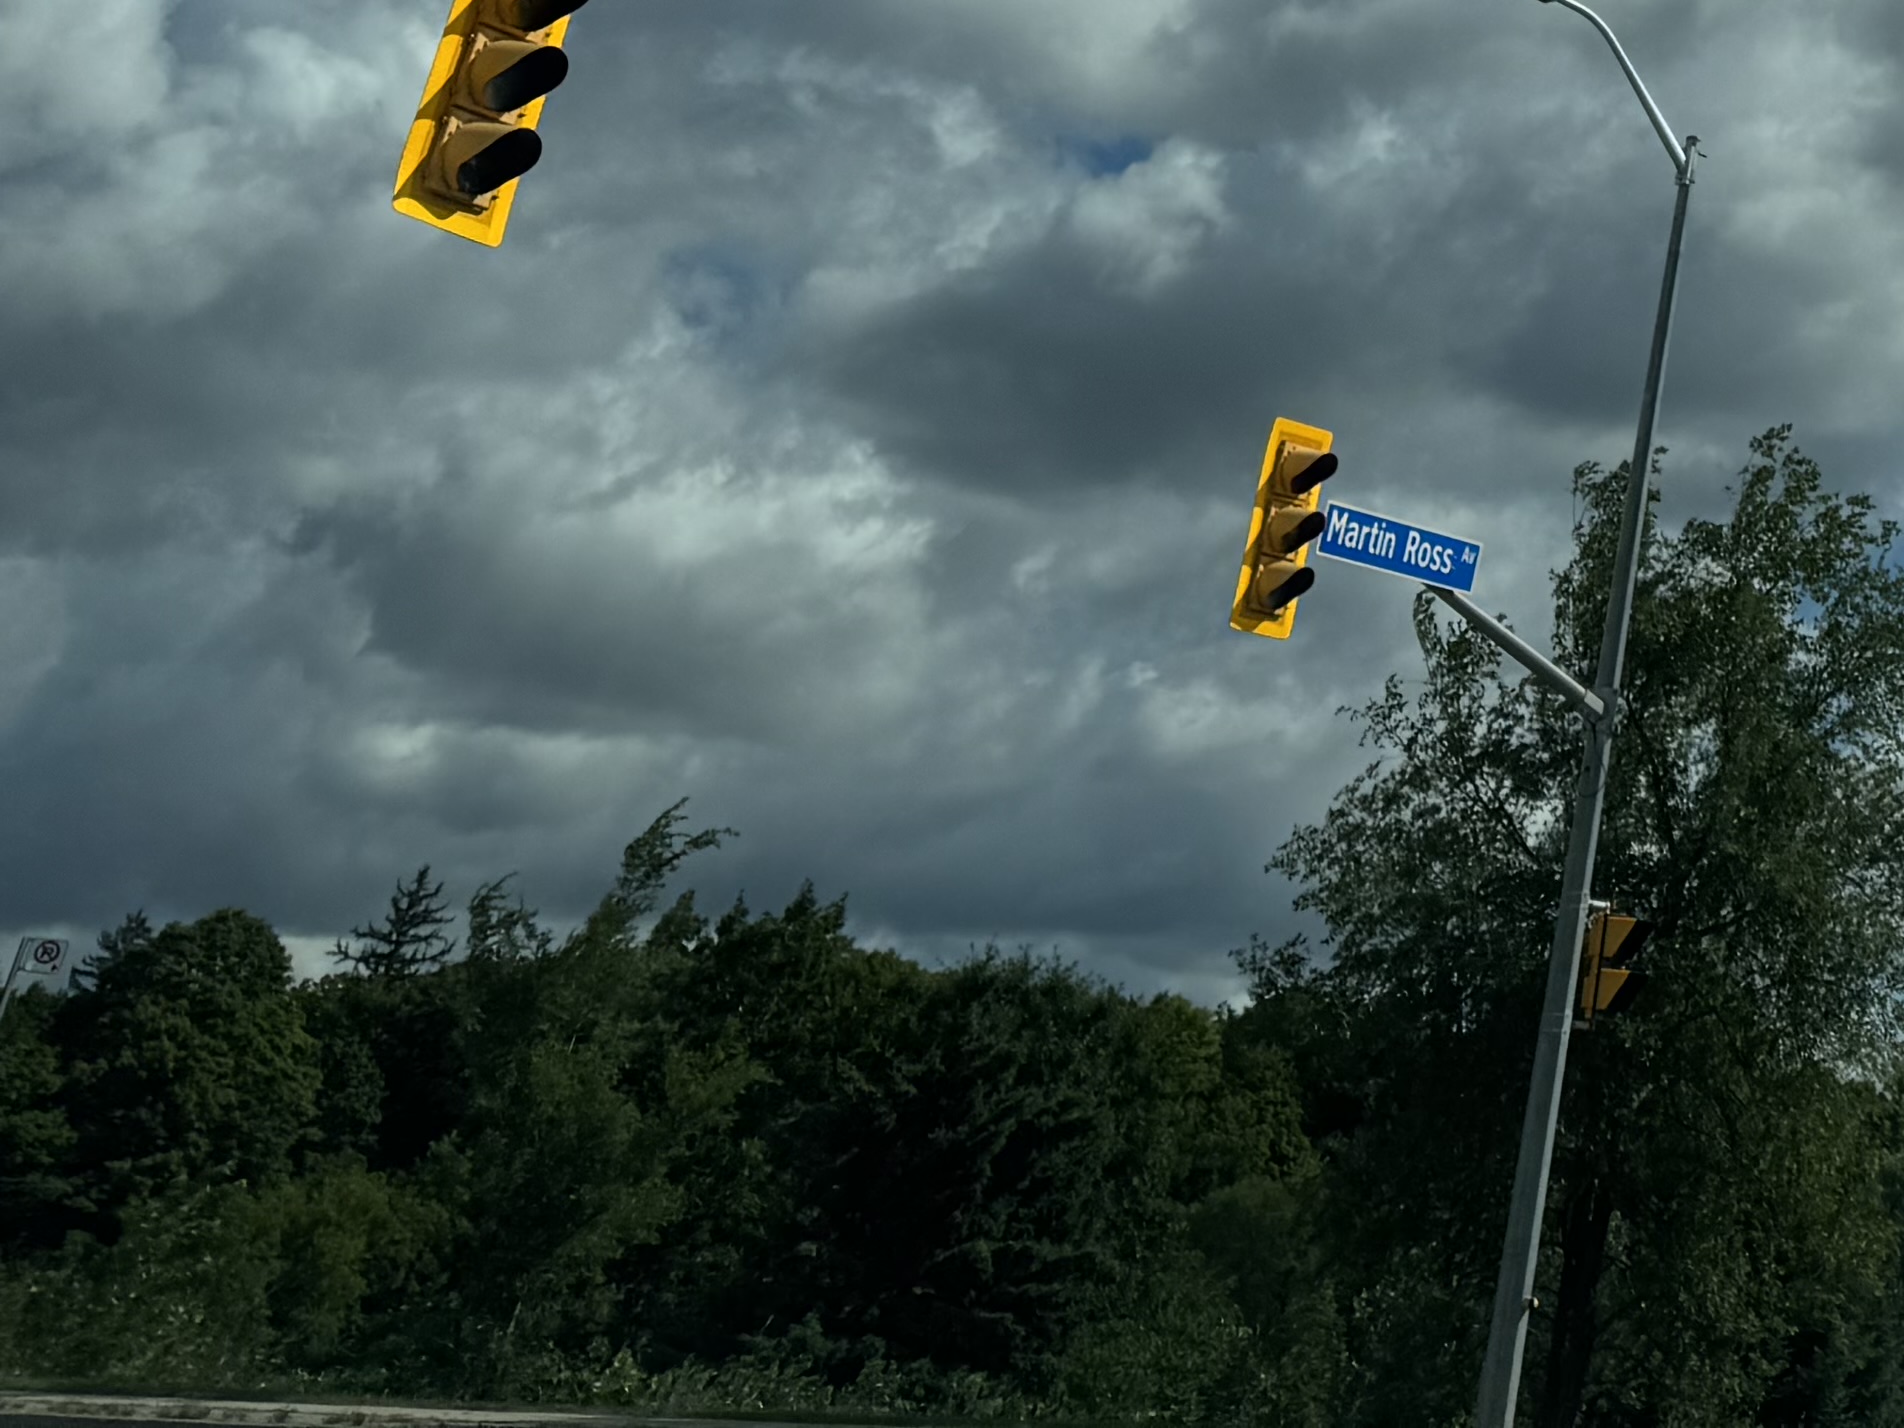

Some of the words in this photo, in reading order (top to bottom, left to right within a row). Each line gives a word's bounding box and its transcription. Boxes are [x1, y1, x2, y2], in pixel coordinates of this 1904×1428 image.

[1326, 509, 1396, 559] Martin
[1403, 530, 1454, 574] Ross
[1461, 545, 1477, 565] Av
